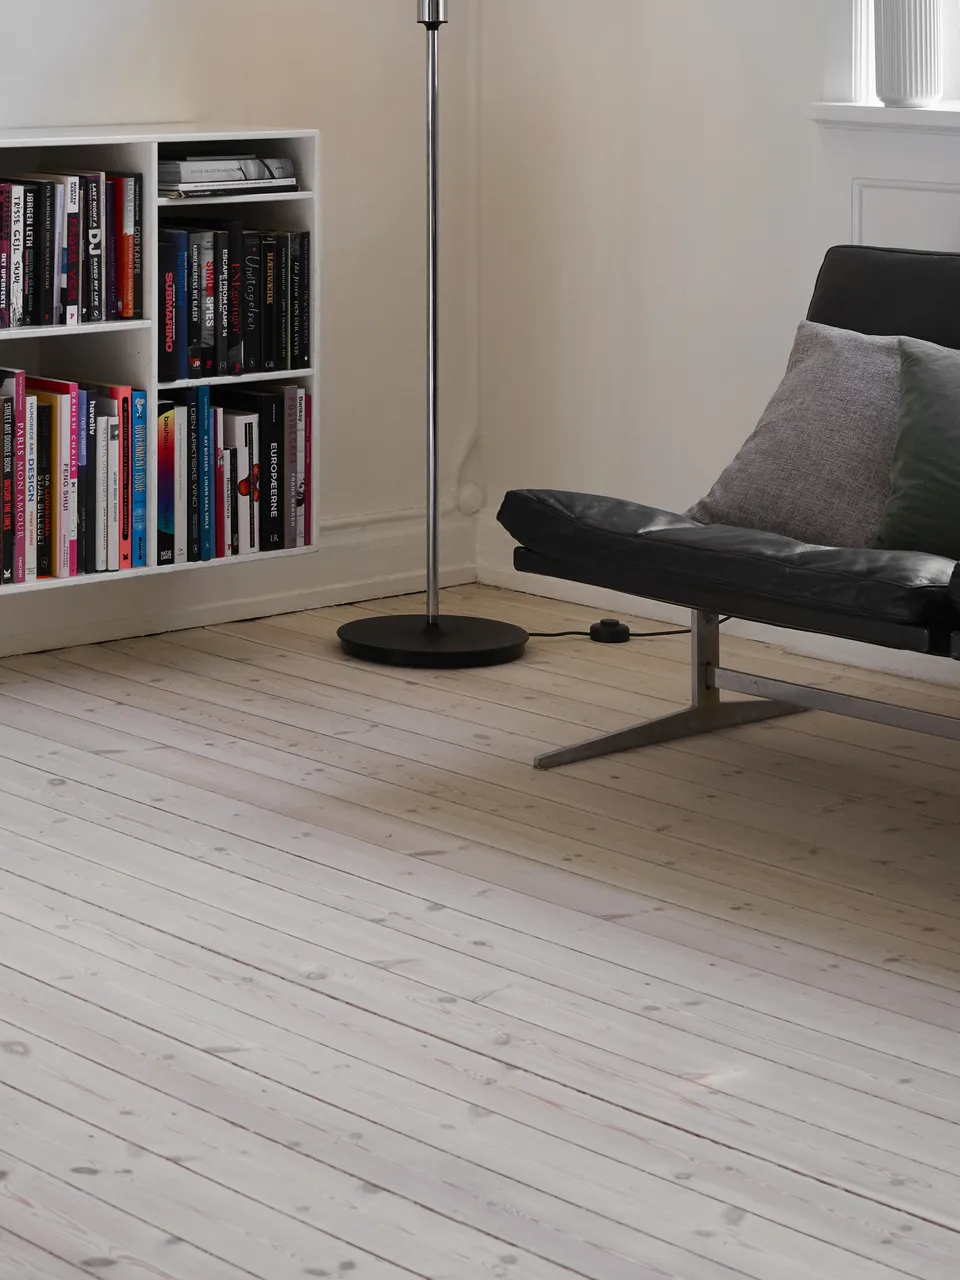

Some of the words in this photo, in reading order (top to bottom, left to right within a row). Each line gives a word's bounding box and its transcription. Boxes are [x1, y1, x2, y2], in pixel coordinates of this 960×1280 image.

[26, 192, 34, 224] JØRGEN
[88, 229, 101, 255] DJ
[205, 261, 214, 297] SIMON
[266, 252, 274, 304] HÆRVÆRK
[165, 272, 173, 353] SUBMARINO
[206, 296, 214, 327] SPIES
[3, 402, 11, 423] STREET
[88, 400, 96, 435] haveliv
[3, 423, 11, 434] ART
[16, 422, 24, 456] PARIS
[3, 434, 11, 457] DOODLE
[134, 424, 145, 470] GOVERNMENT
[3, 457, 11, 473] BOOK
[16, 461, 24, 490] MON
[27, 458, 35, 502] DESIGN
[270, 443, 278, 518] EUROPÆERNE
[3, 479, 11, 502] OUTSIDE
[134, 472, 145, 492] ISSUE
[3, 503, 11, 513] THE
[3, 514, 11, 530] LINES
[16, 493, 24, 539] AMOUR
